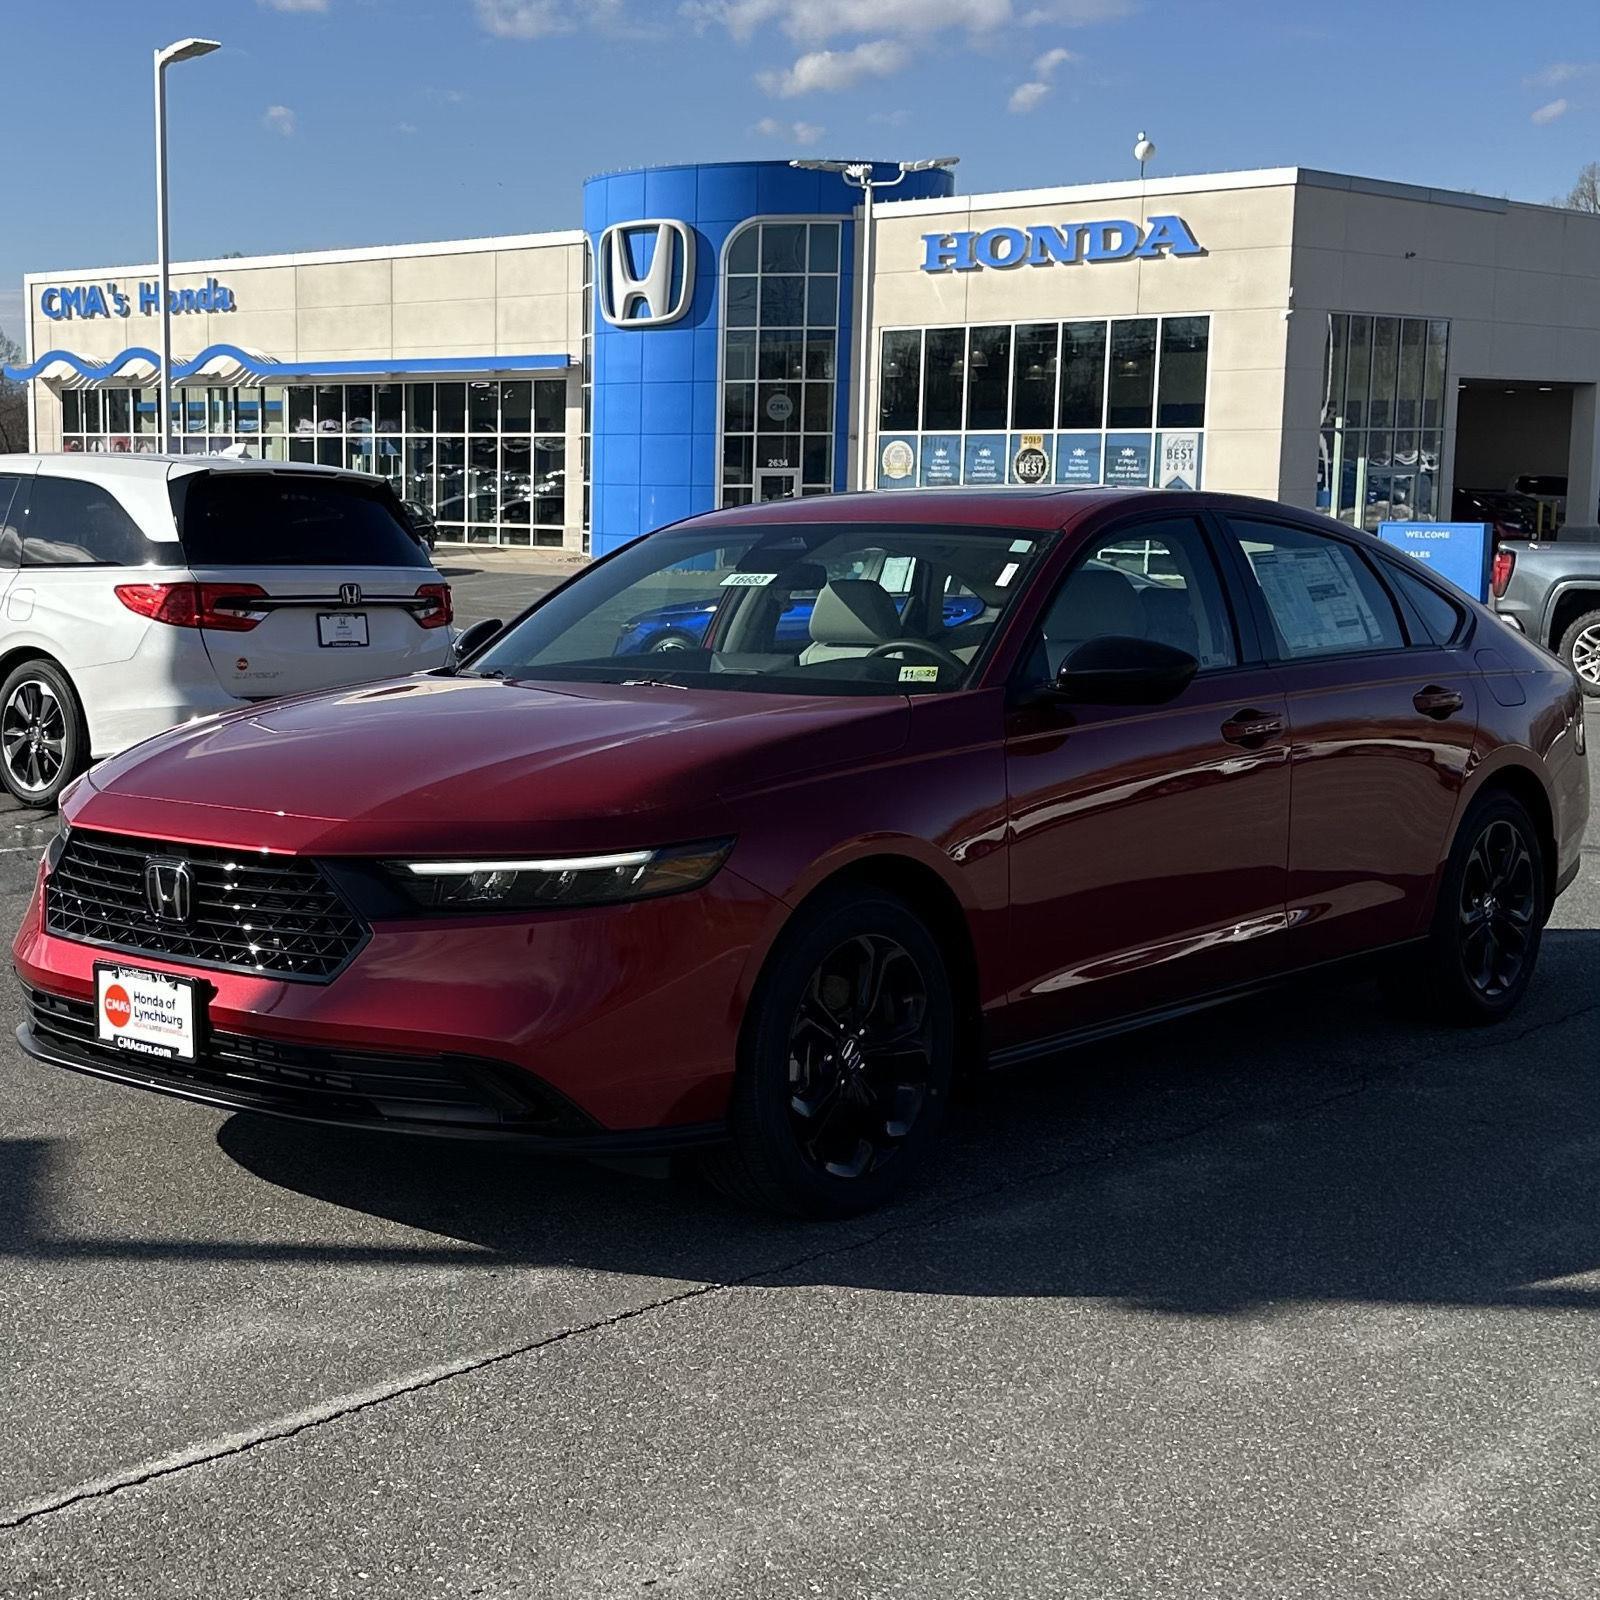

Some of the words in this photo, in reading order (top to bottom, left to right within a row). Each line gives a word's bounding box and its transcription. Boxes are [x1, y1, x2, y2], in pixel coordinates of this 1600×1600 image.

[920, 215, 1206, 272] HONDA
[41, 282, 130, 320] CMA's
[1023, 435, 1042, 444] 2019
[1166, 448, 1194, 460] BEST
[768, 459, 789, 467] 2634
[1018, 463, 1043, 474] BEST
[1166, 463, 1194, 471] 2020
[1405, 530, 1451, 539] WELCOME
[903, 669, 914, 679] 11
[105, 998, 130, 1013] CMA's
[133, 991, 164, 1009] Honda
[165, 998, 176, 1010] of
[134, 1006, 183, 1029] Lynchburg
[117, 1036, 172, 1058] CMAcars.com
